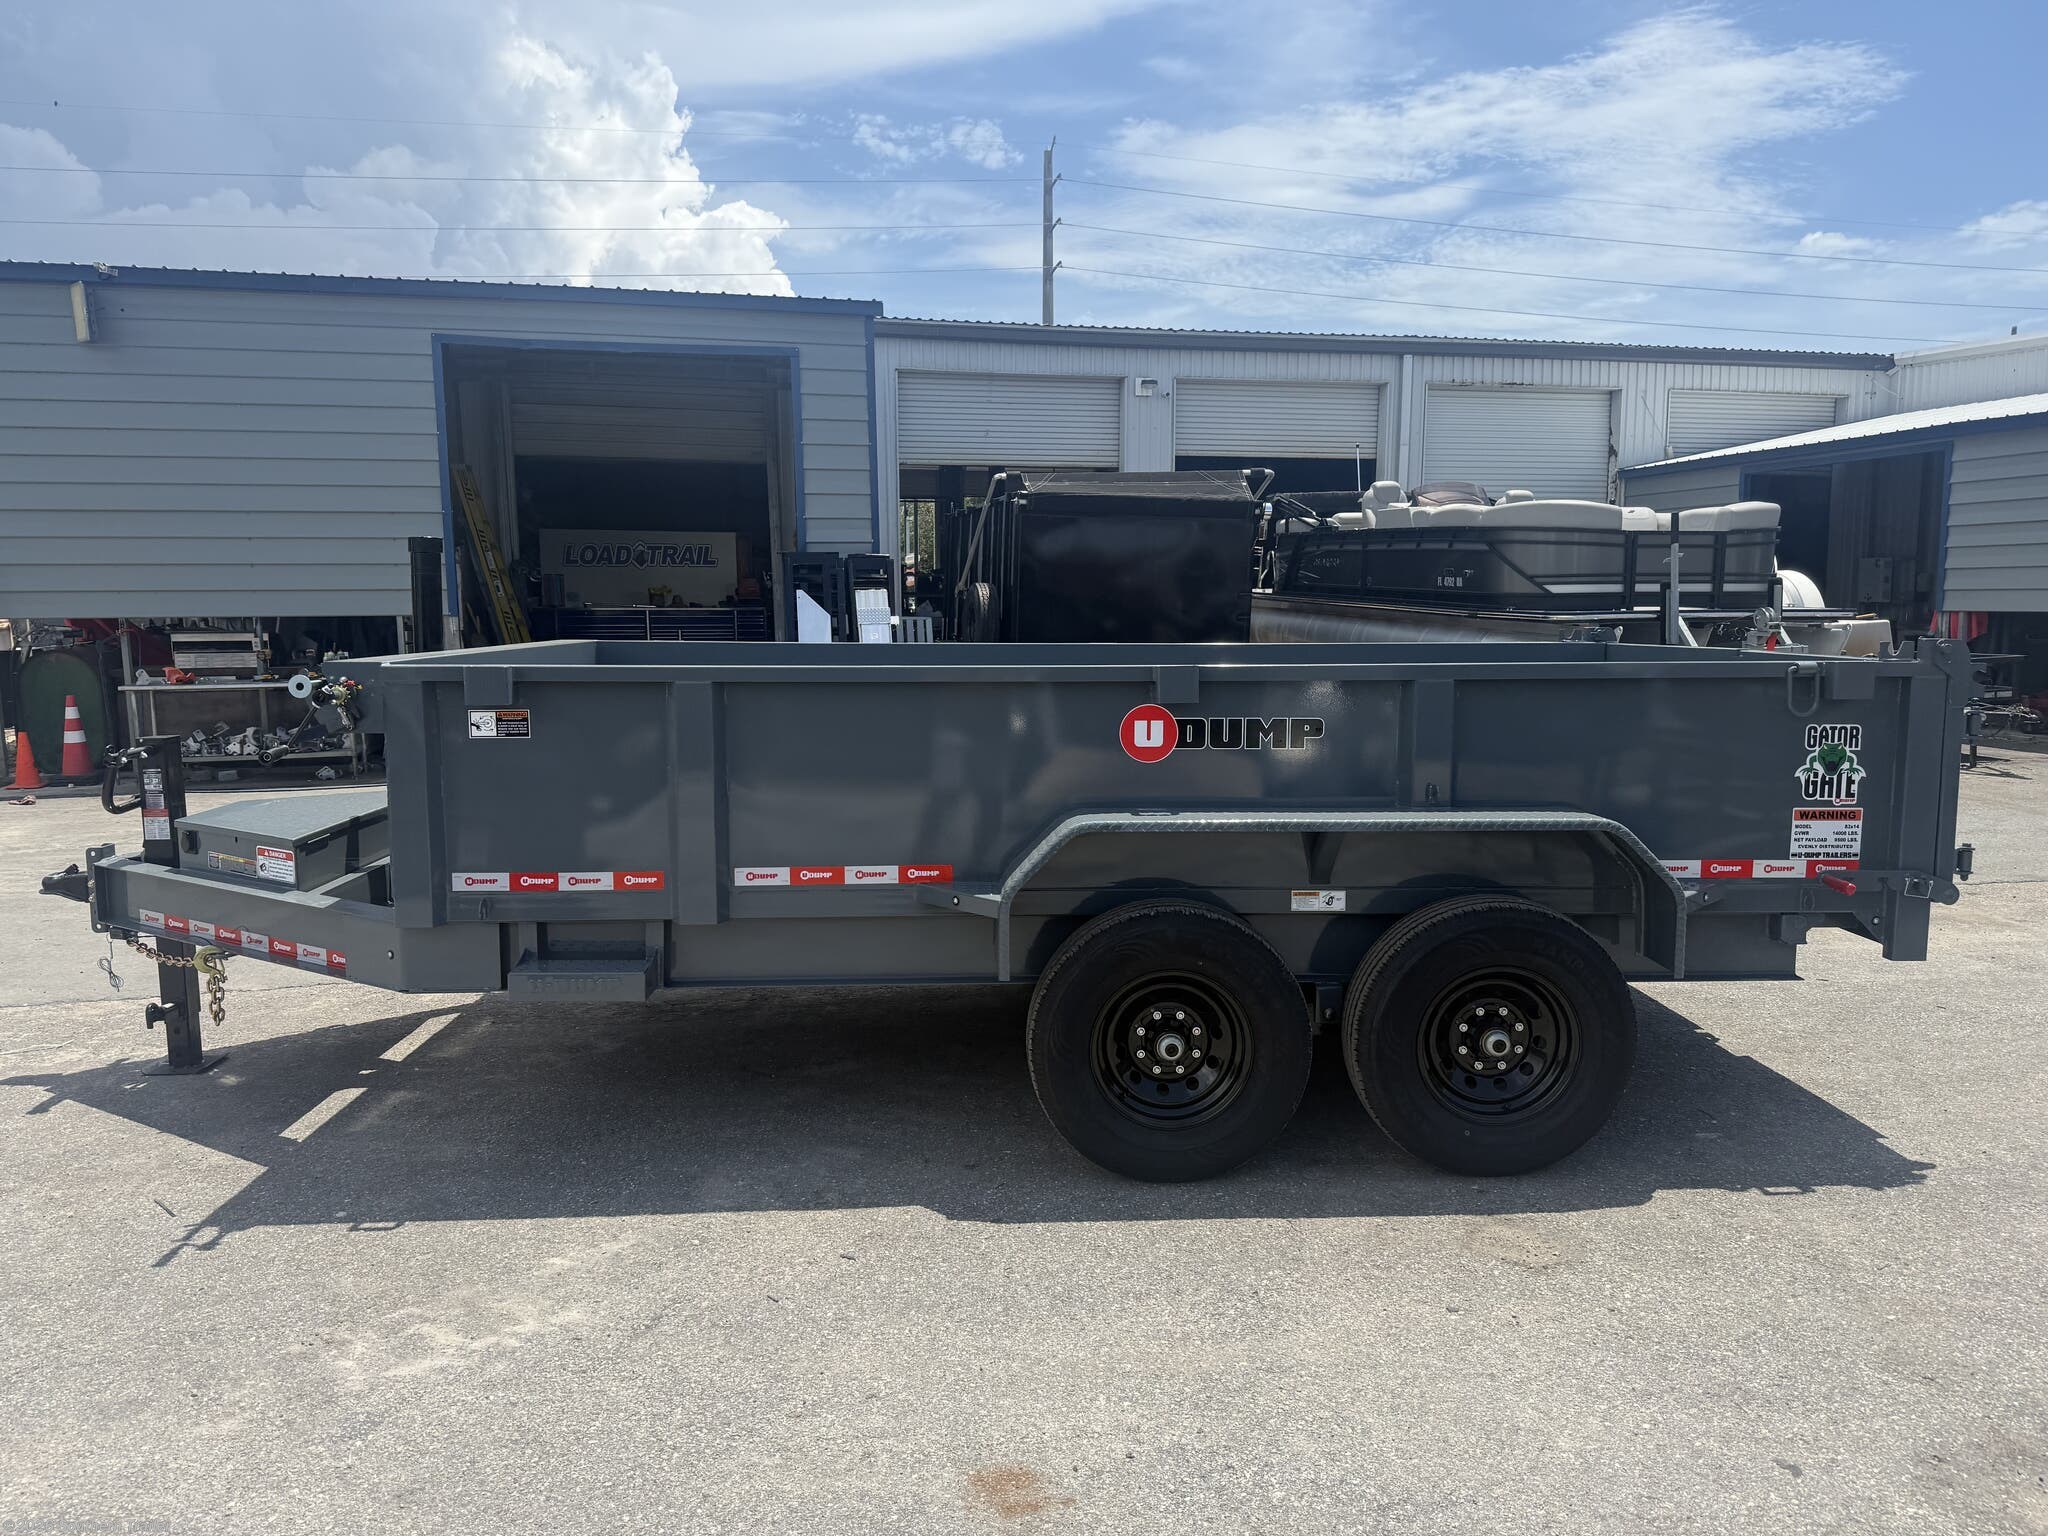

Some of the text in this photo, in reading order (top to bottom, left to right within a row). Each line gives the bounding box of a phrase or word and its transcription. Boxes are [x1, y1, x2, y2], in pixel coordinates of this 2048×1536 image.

[563, 543, 718, 567] LOAD TRAIL
[1806, 725, 1860, 749] GATOR
[1799, 811, 1856, 820] WARNING
